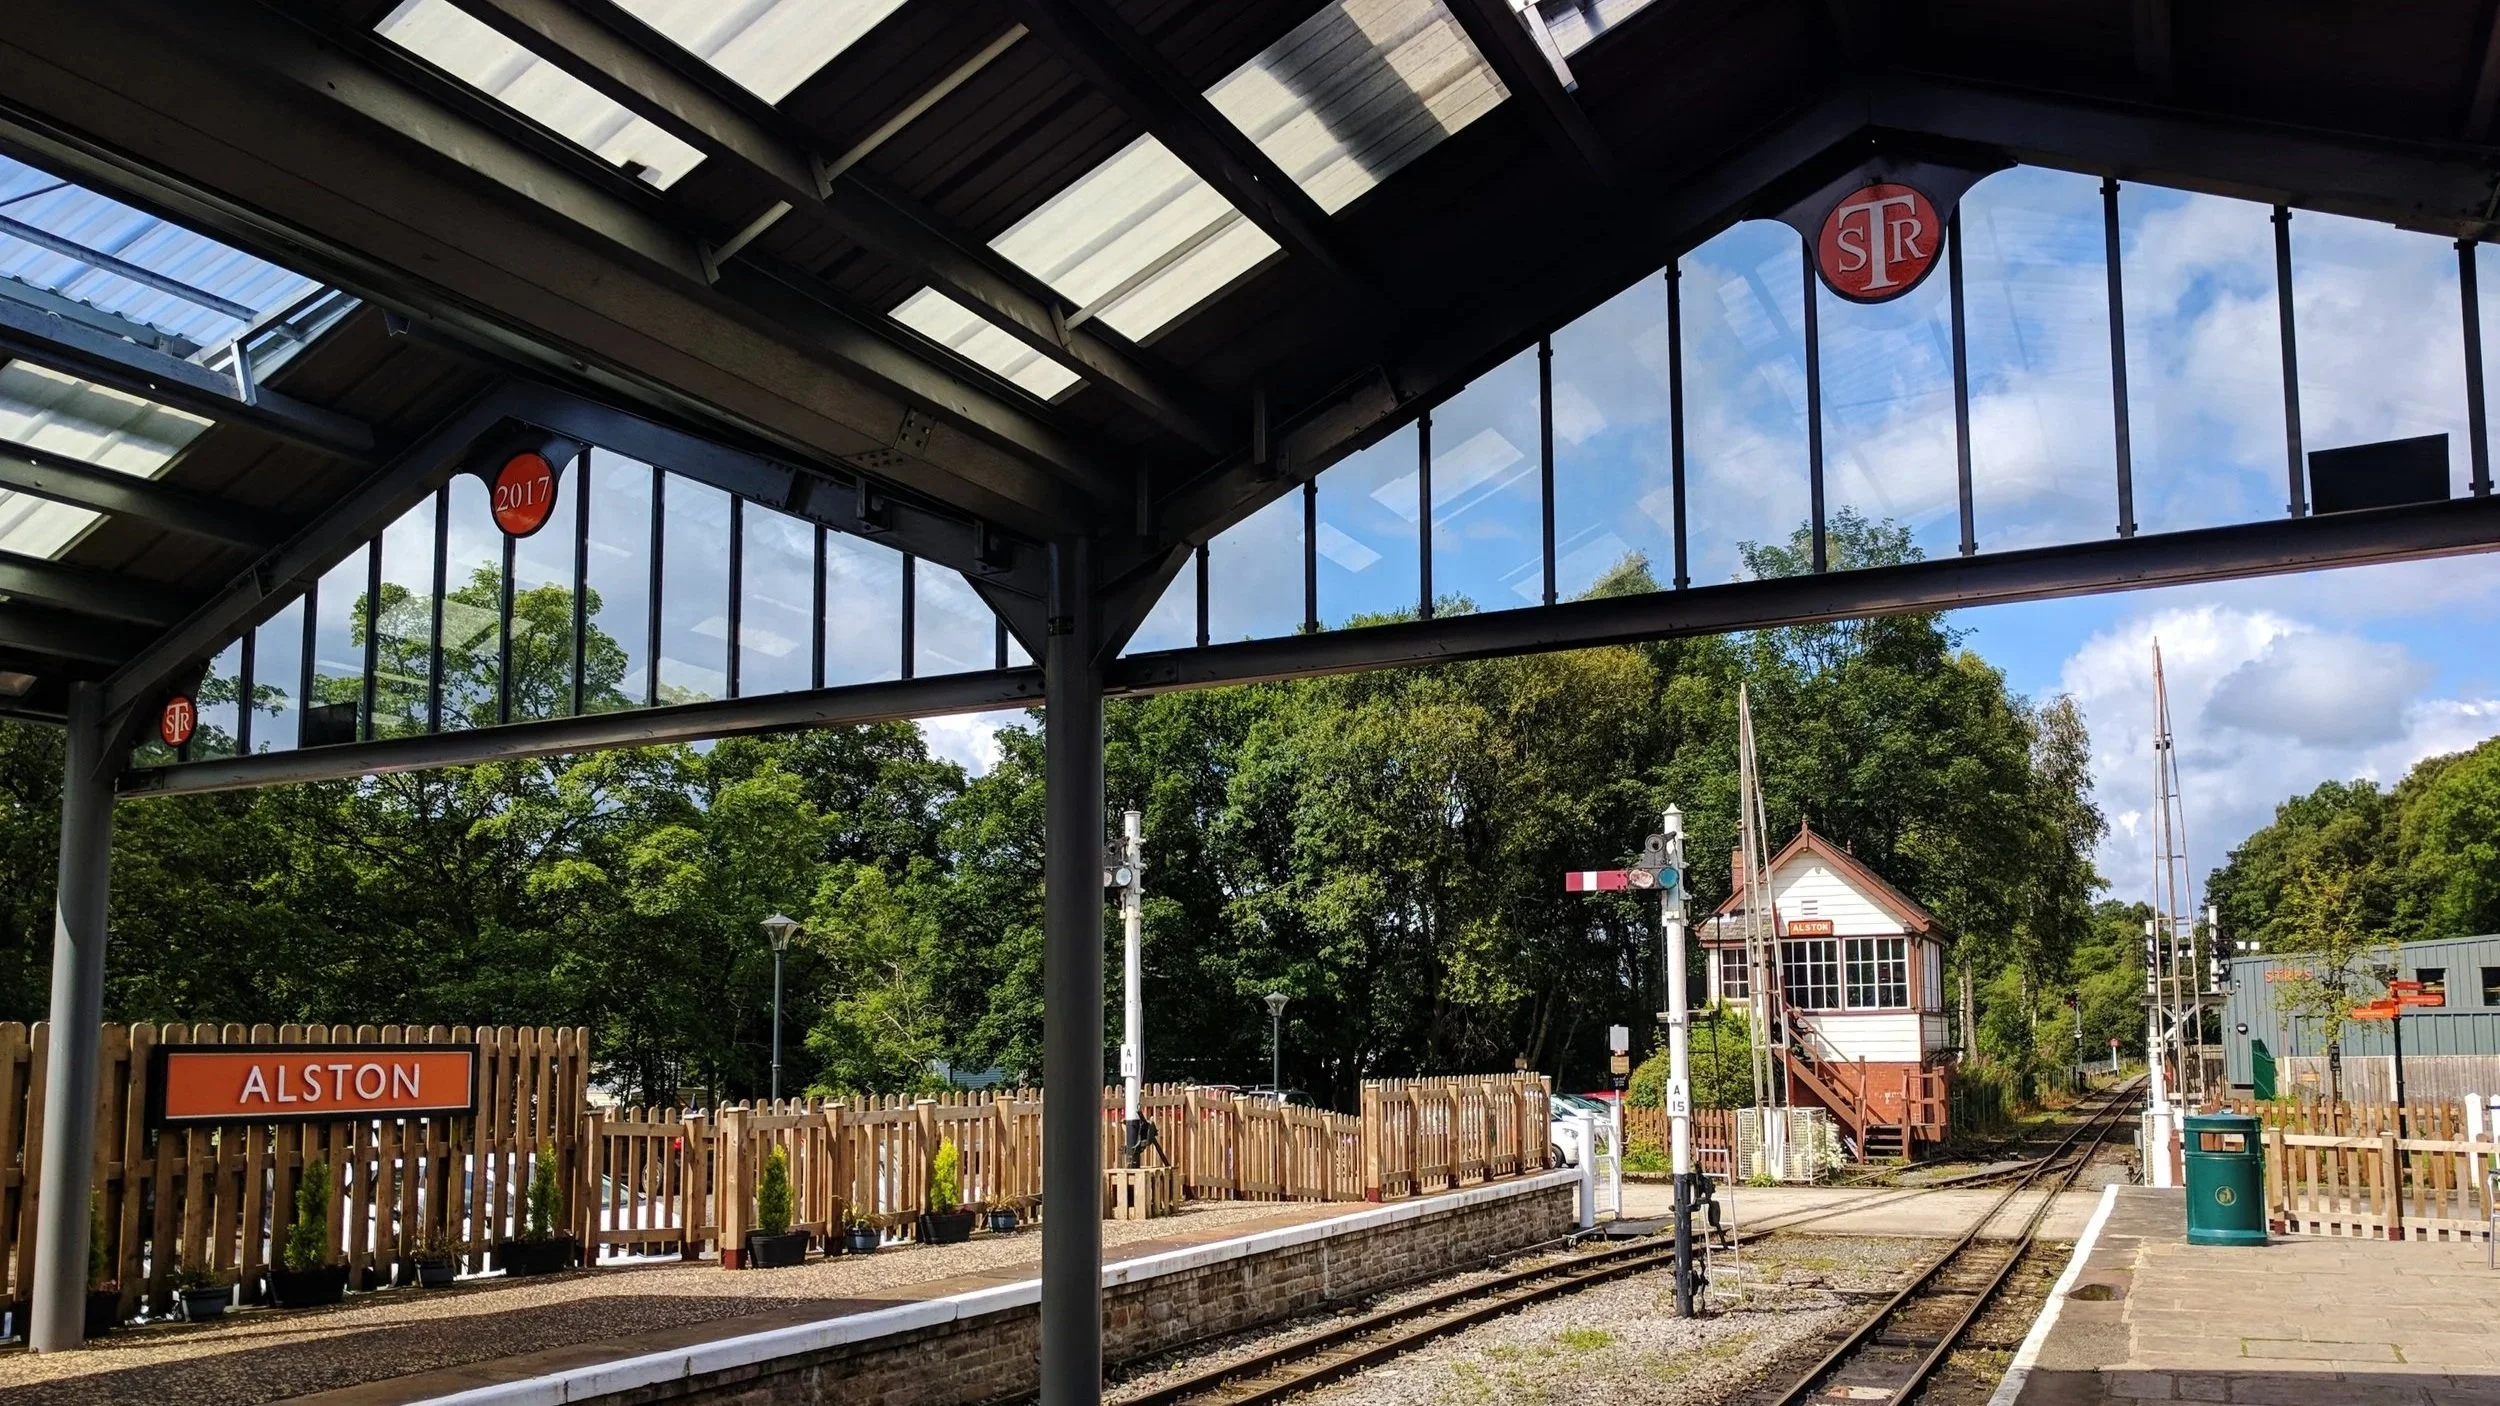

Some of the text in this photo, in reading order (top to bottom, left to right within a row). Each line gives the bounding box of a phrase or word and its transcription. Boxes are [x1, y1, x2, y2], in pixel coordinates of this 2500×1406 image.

[1837, 194, 1928, 291] STR
[496, 475, 550, 512] 2017
[165, 702, 191, 743] STR
[1793, 923, 1828, 932] ALSTON
[1126, 1048, 1132, 1057] A
[239, 1063, 420, 1104] ALSTON
[1673, 1085, 1681, 1095] A
[1672, 1101, 1685, 1112] 15
